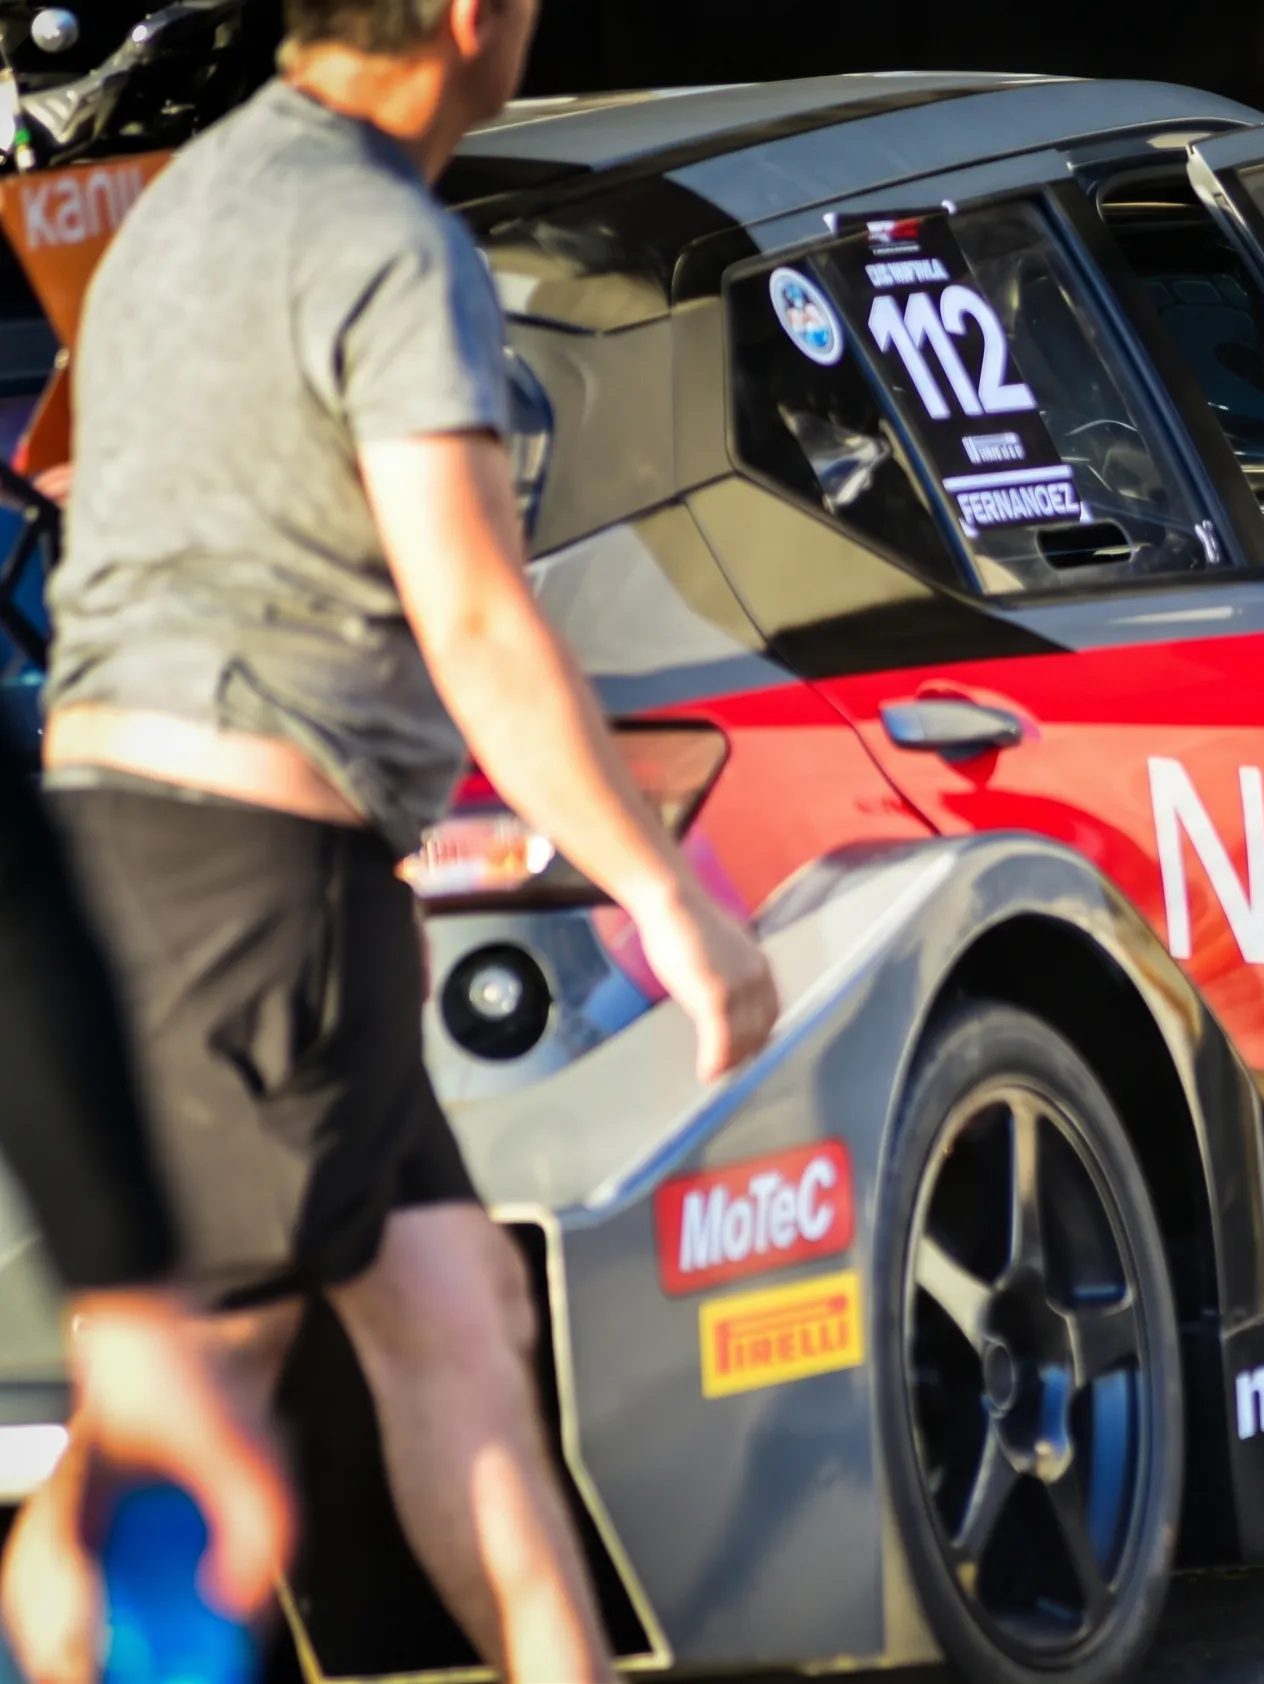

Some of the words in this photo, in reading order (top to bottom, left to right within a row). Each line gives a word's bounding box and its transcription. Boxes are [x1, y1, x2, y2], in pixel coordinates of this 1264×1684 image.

[868, 285, 1036, 419] 112
[679, 1156, 837, 1273] MoTeC
[714, 1295, 848, 1375] PIRELLI
